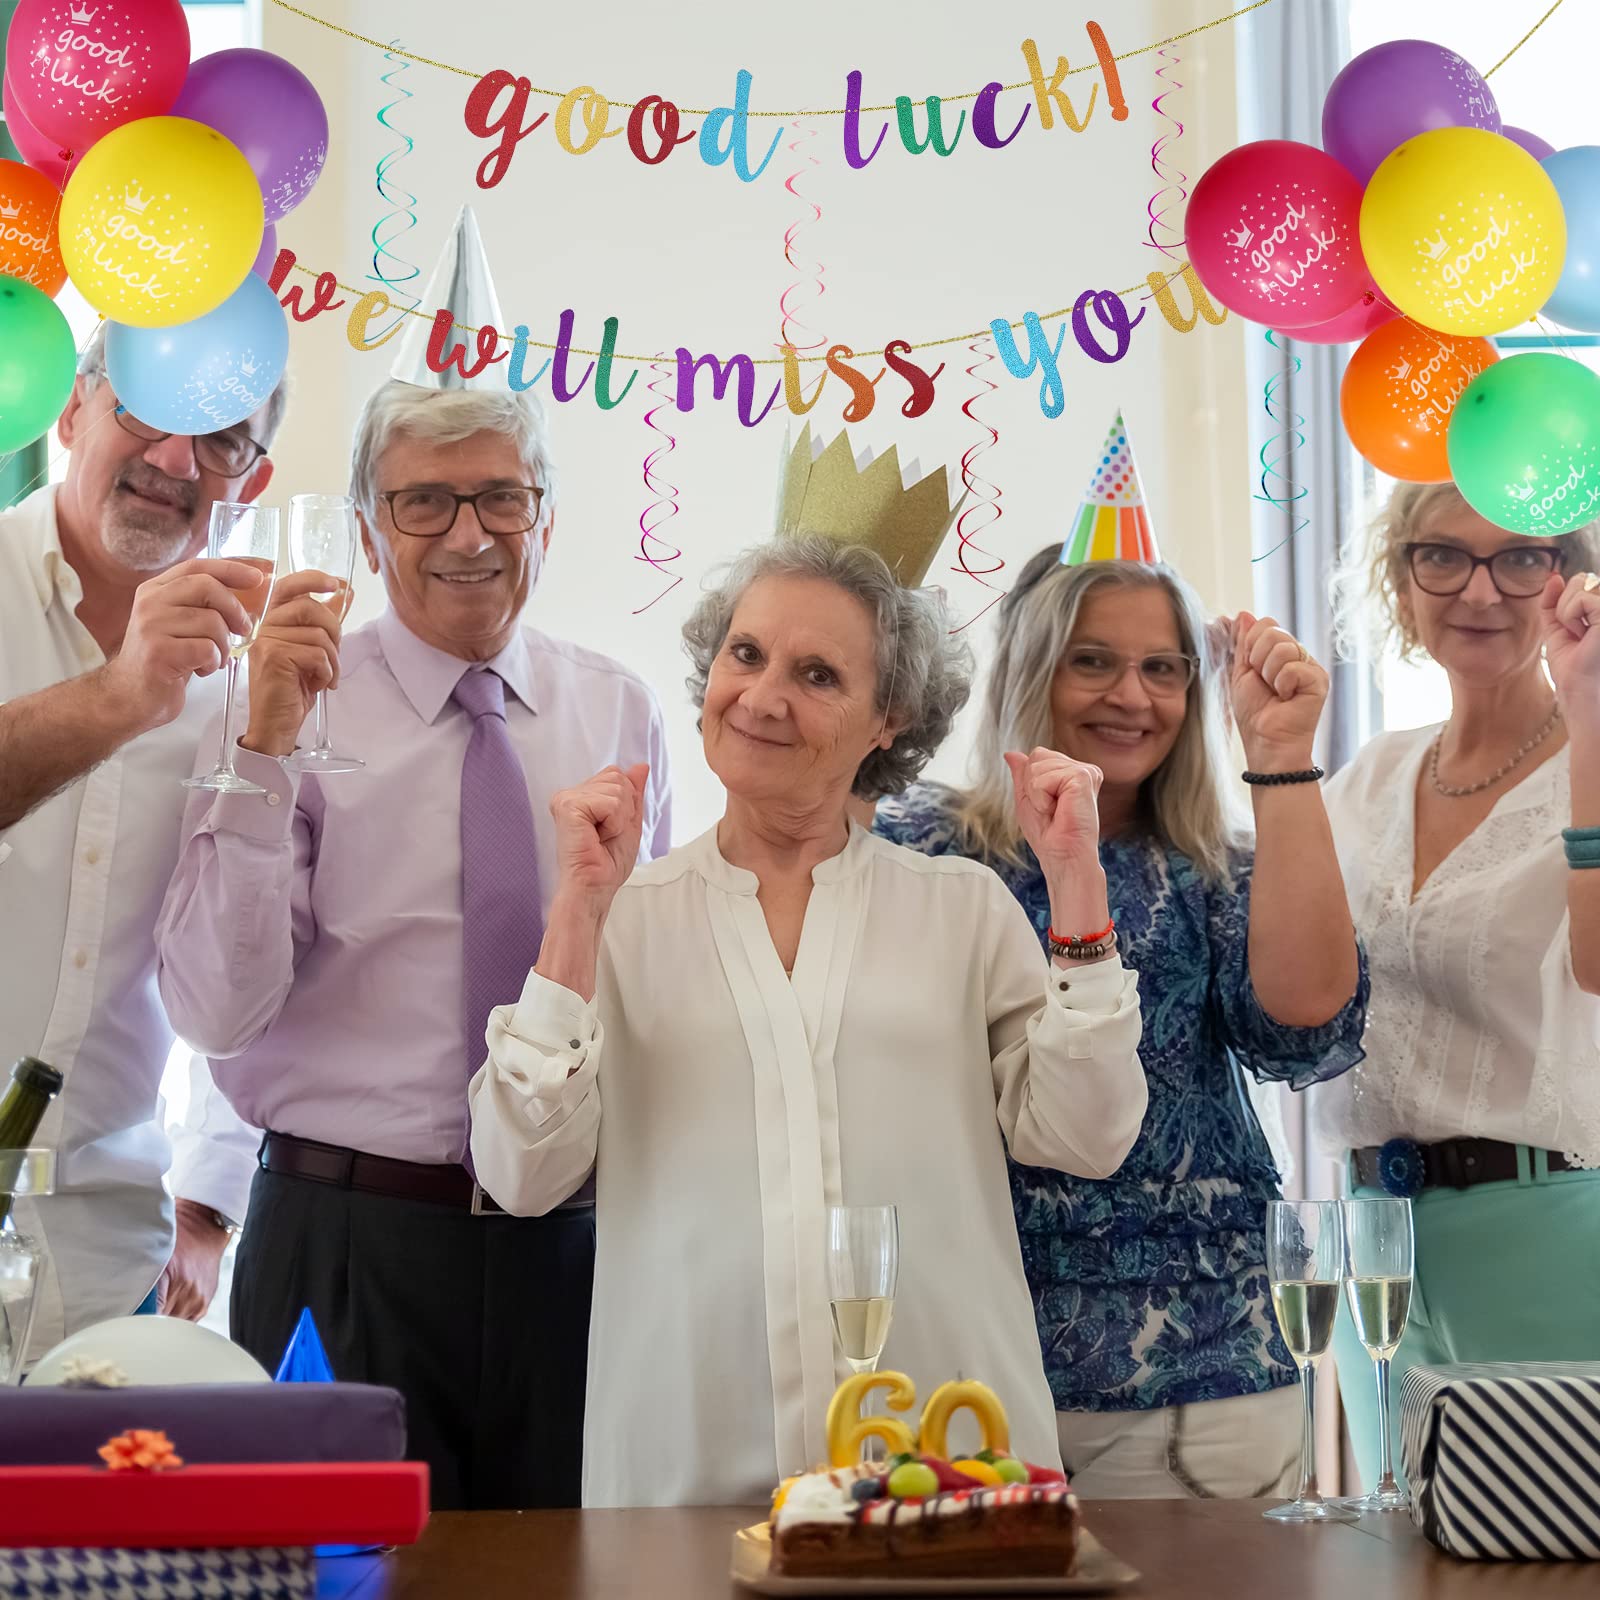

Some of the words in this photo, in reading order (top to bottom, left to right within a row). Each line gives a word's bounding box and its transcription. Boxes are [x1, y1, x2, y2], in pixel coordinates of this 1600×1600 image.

[54, 27, 134, 69] good
[50, 58, 124, 105] luck
[463, 68, 784, 190] good
[843, 20, 1130, 170] luck!
[103, 213, 189, 266] good
[1251, 202, 1306, 274] good
[1275, 225, 1336, 288] luck
[1442, 215, 1510, 290] good
[0, 261, 43, 285] ck
[90, 241, 171, 300] luck
[1463, 246, 1536, 308] luck
[268, 248, 404, 351] we
[426, 308, 640, 411] will
[675, 339, 946, 427] miss
[989, 260, 1229, 419] you
[1411, 341, 1455, 400] good
[1529, 463, 1586, 520] good
[1547, 485, 1600, 529] luck
[825, 1369, 1010, 1468] 60
